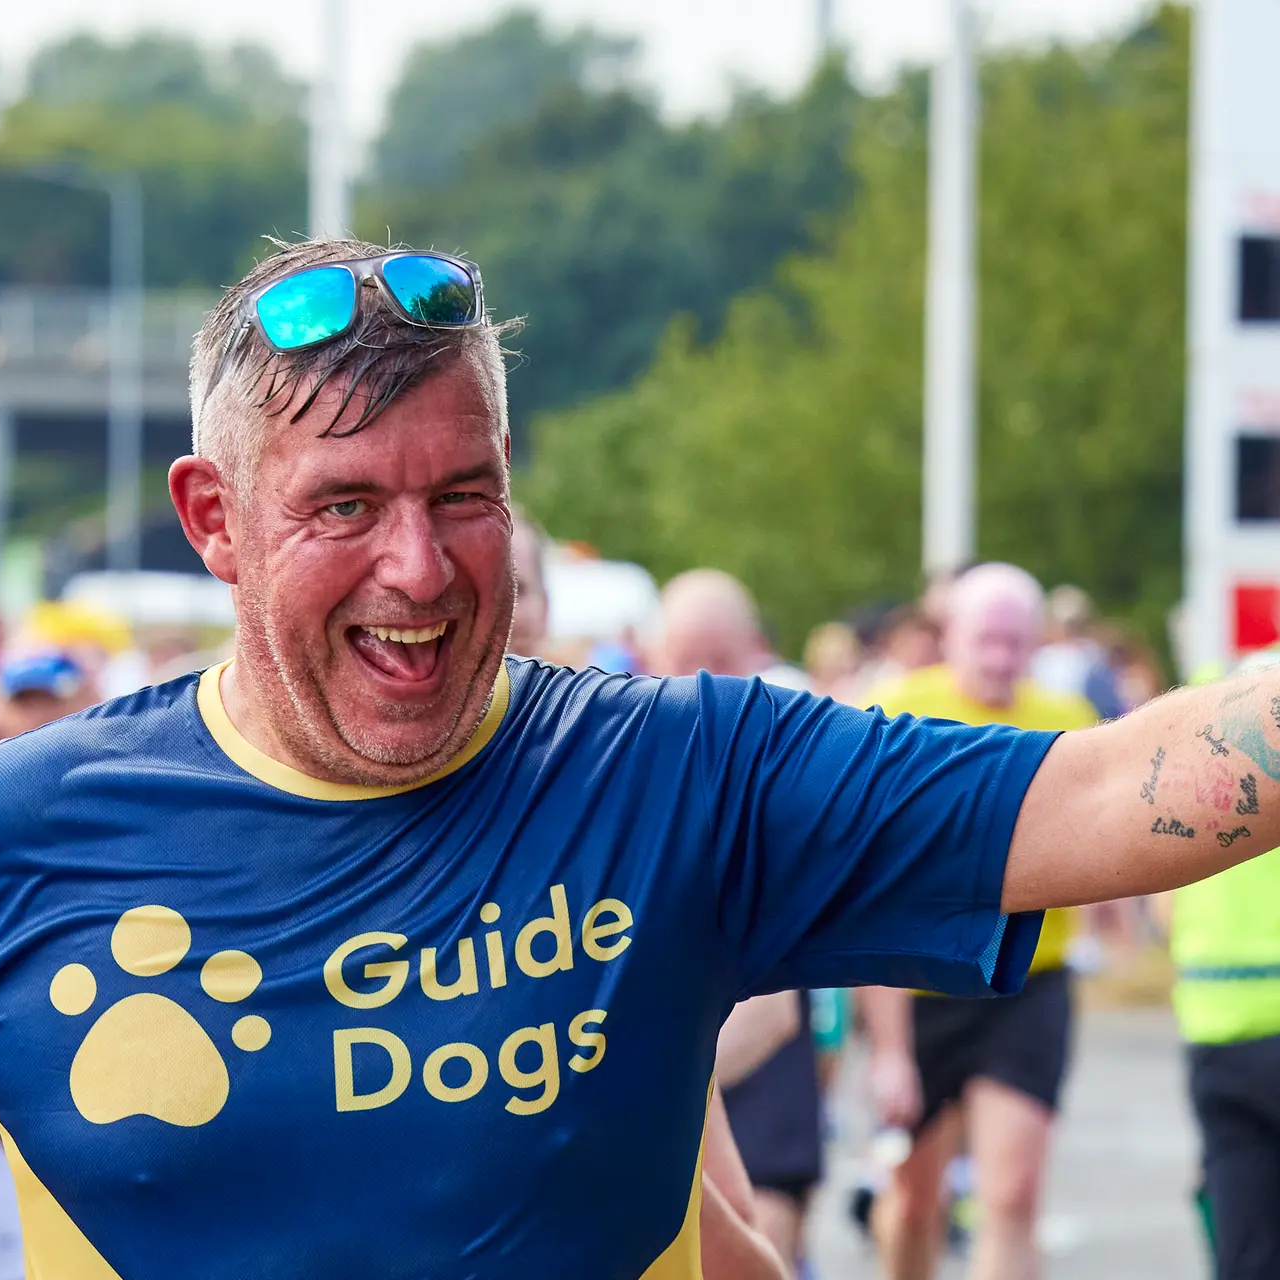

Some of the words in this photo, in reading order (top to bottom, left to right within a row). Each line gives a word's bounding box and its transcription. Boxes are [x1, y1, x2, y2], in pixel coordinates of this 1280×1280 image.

[1151, 816, 1196, 839] Lillie
[323, 883, 634, 1010] Guide
[332, 1008, 608, 1116] Dogs
